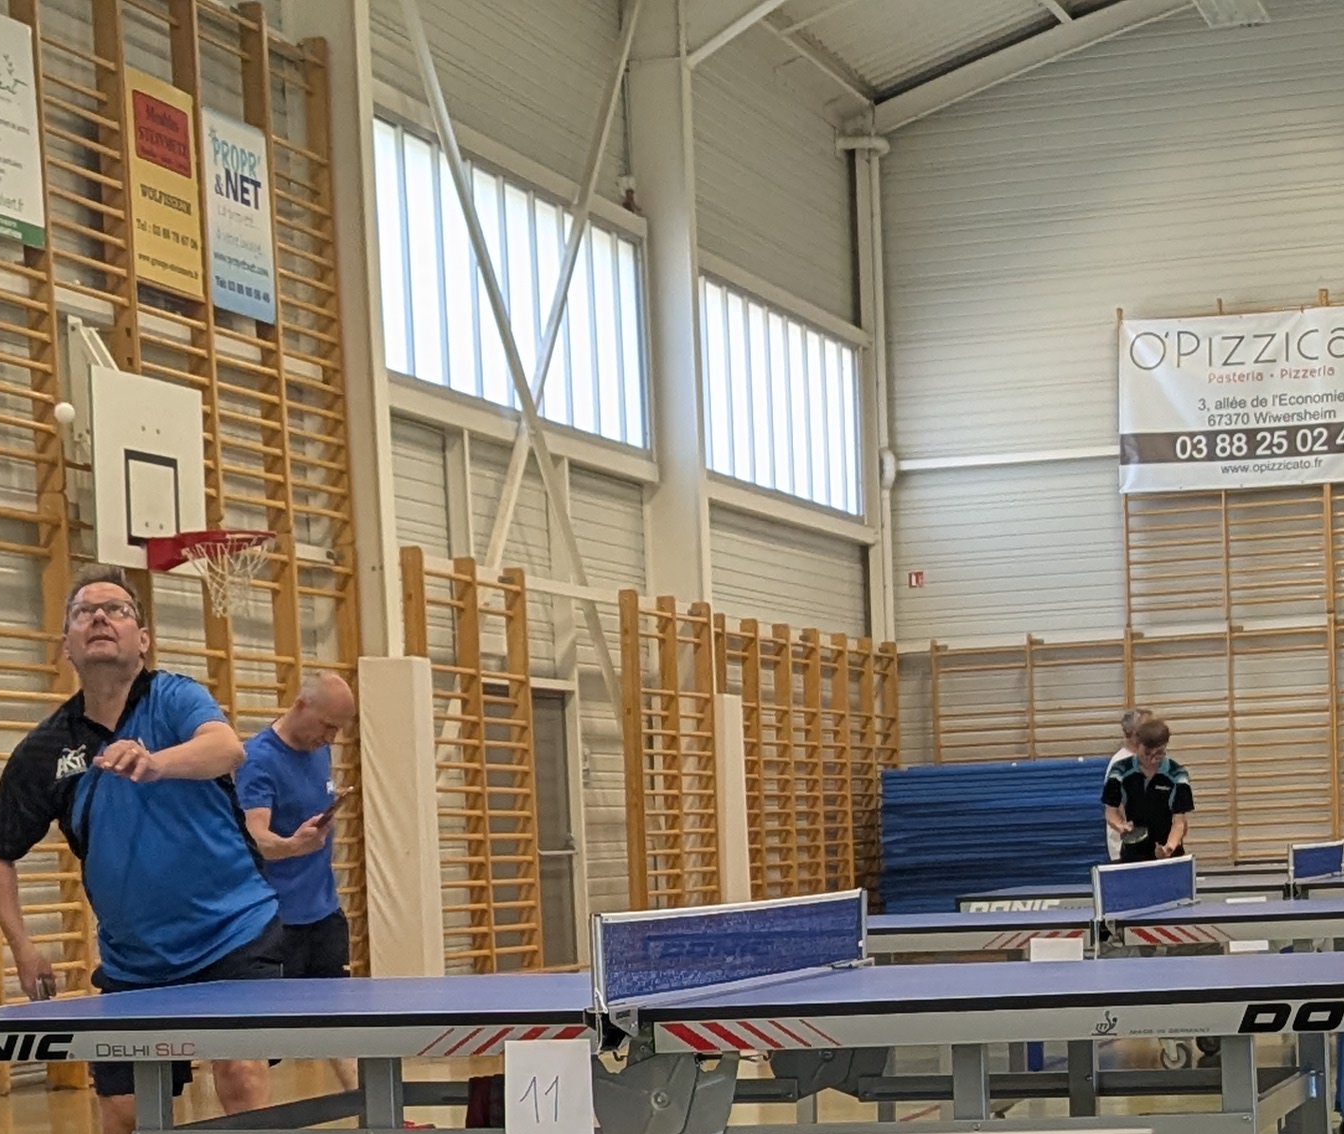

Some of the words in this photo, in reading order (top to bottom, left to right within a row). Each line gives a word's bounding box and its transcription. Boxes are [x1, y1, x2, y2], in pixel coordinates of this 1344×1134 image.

[1198, 398, 1211, 413] 3,
[1214, 395, 1247, 411] allée
[1251, 394, 1268, 408] de
[1207, 411, 1250, 427] 67370
[1253, 408, 1337, 425] Wiwersheim
[1175, 436, 1207, 460] 03
[1215, 432, 1248, 457] 88
[1256, 431, 1288, 455] 25
[1296, 427, 1328, 452] 02
[1220, 456, 1324, 475] www.opizzicato.fr
[155, 1041, 196, 1057] SLC
[519, 1075, 560, 1123] 11
